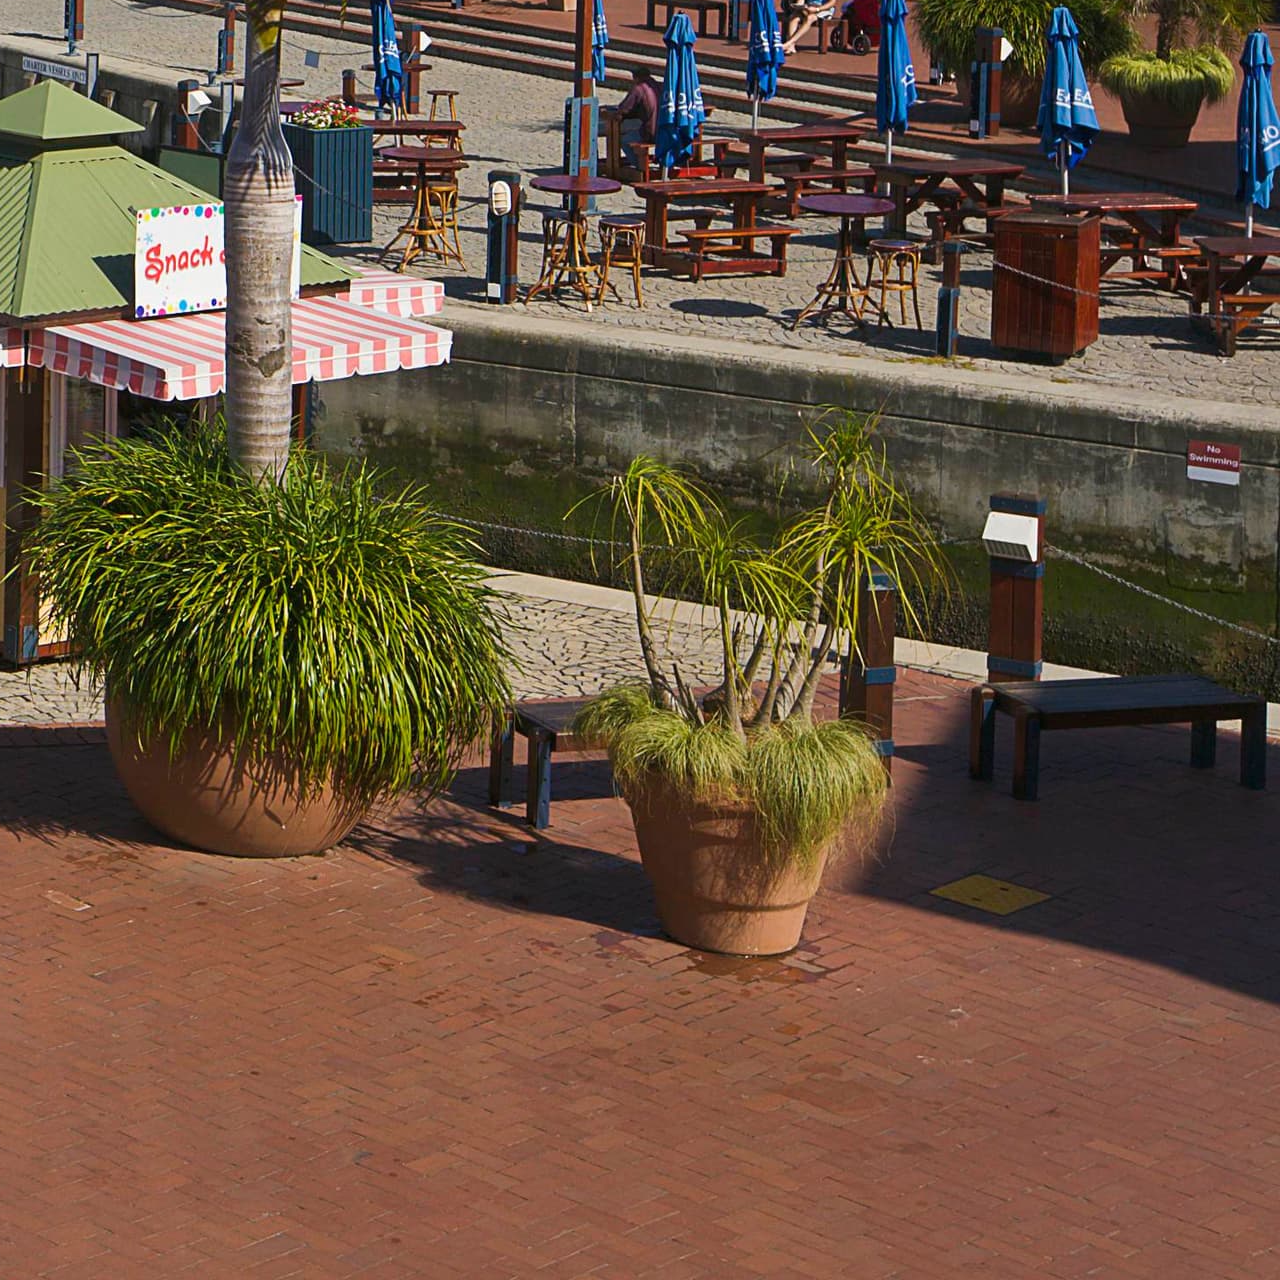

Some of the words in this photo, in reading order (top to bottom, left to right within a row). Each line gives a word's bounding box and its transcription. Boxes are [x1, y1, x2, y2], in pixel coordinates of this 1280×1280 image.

[144, 235, 213, 283] Snack
[1206, 445, 1221, 454] No
[1189, 452, 1239, 468] Swimming
